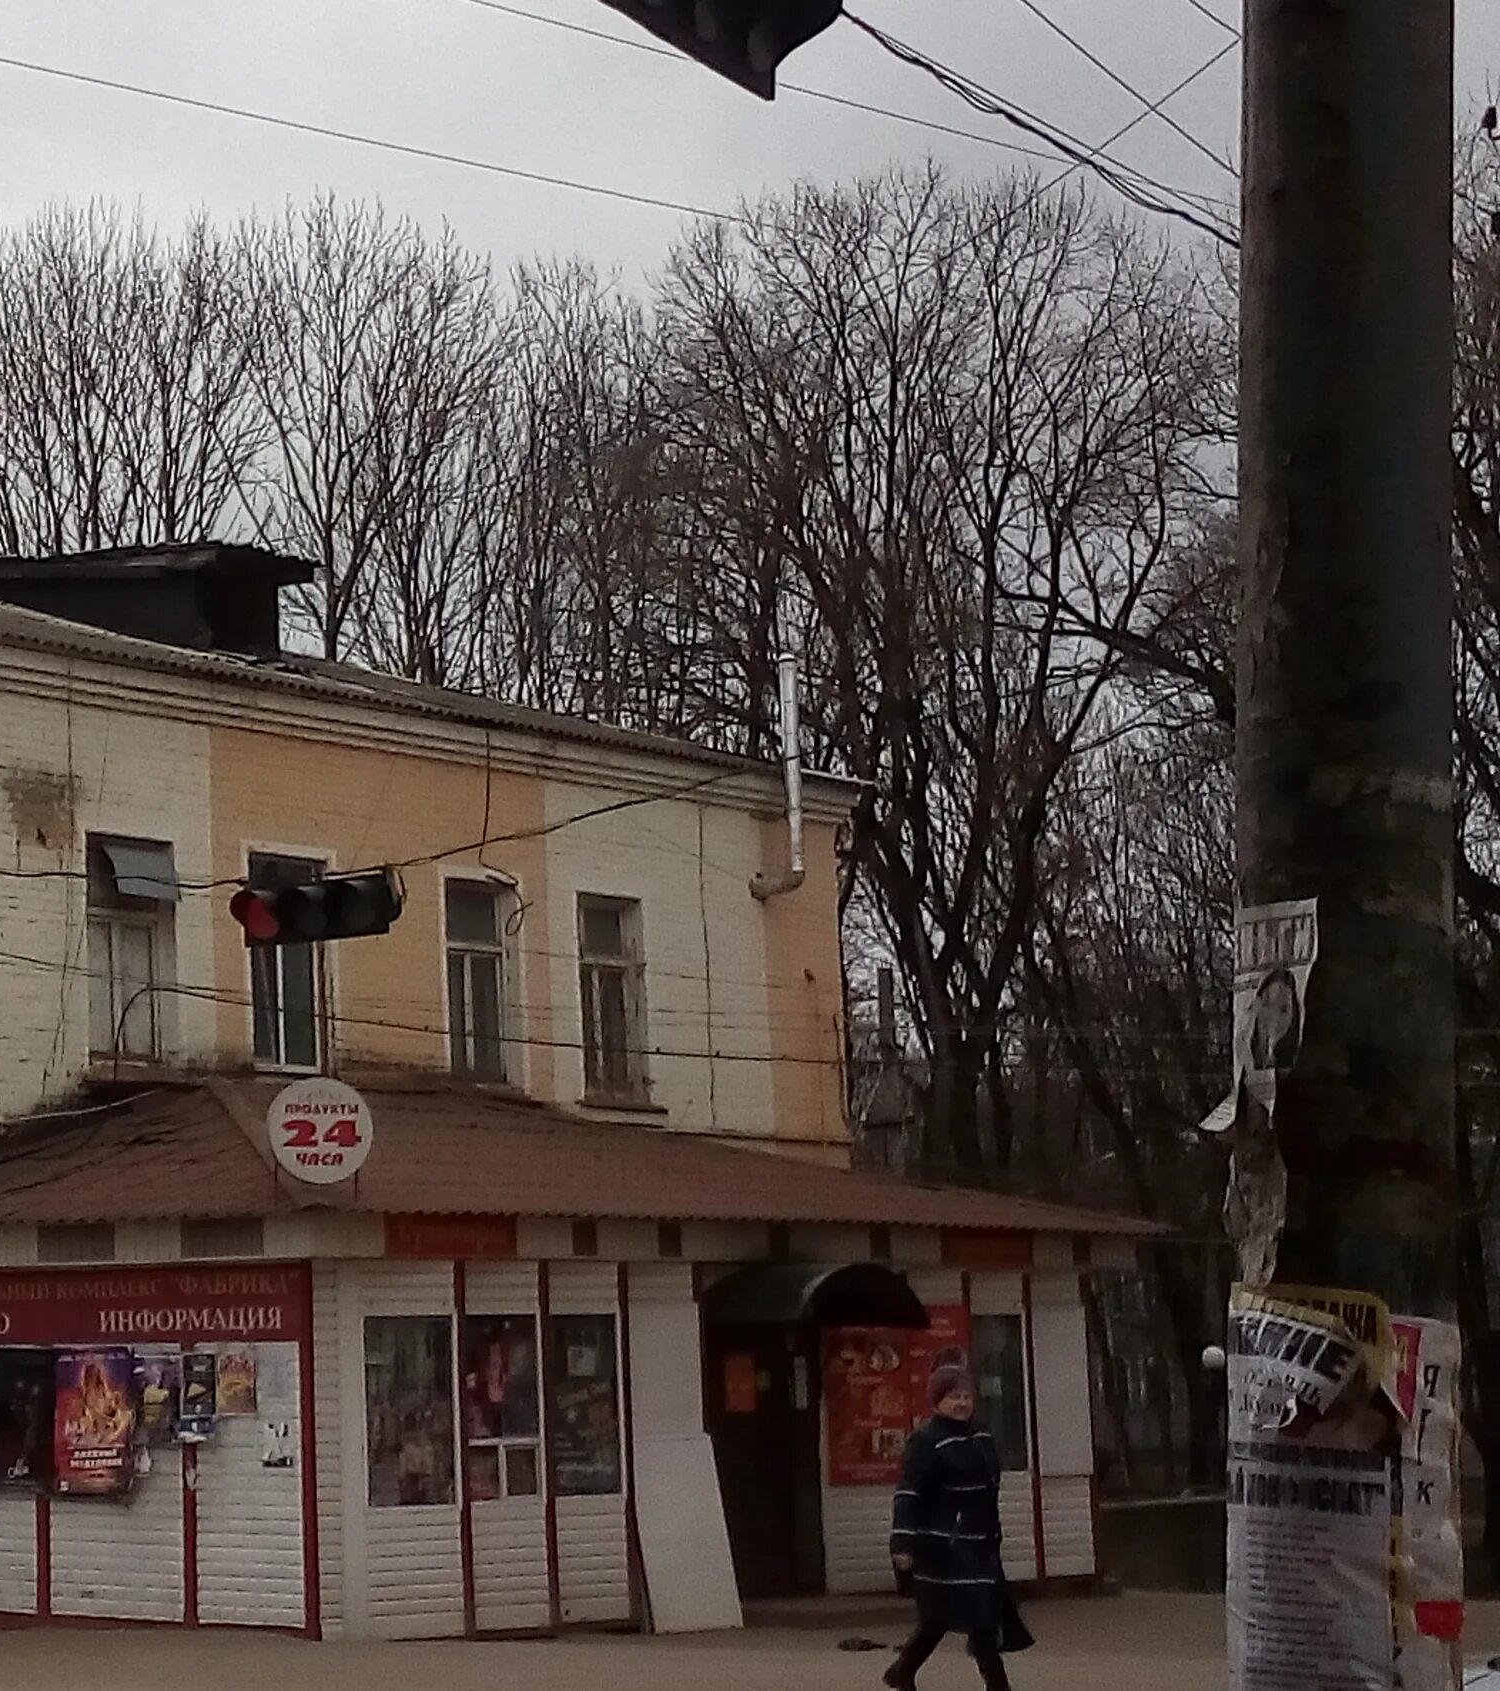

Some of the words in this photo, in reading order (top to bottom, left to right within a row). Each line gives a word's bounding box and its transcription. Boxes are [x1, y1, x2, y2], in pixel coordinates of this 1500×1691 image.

[282, 1120, 362, 1147] 24
[296, 1153, 343, 1166] ЧАСА
[99, 1306, 282, 1335] ИНФОРМАЦИЯ
